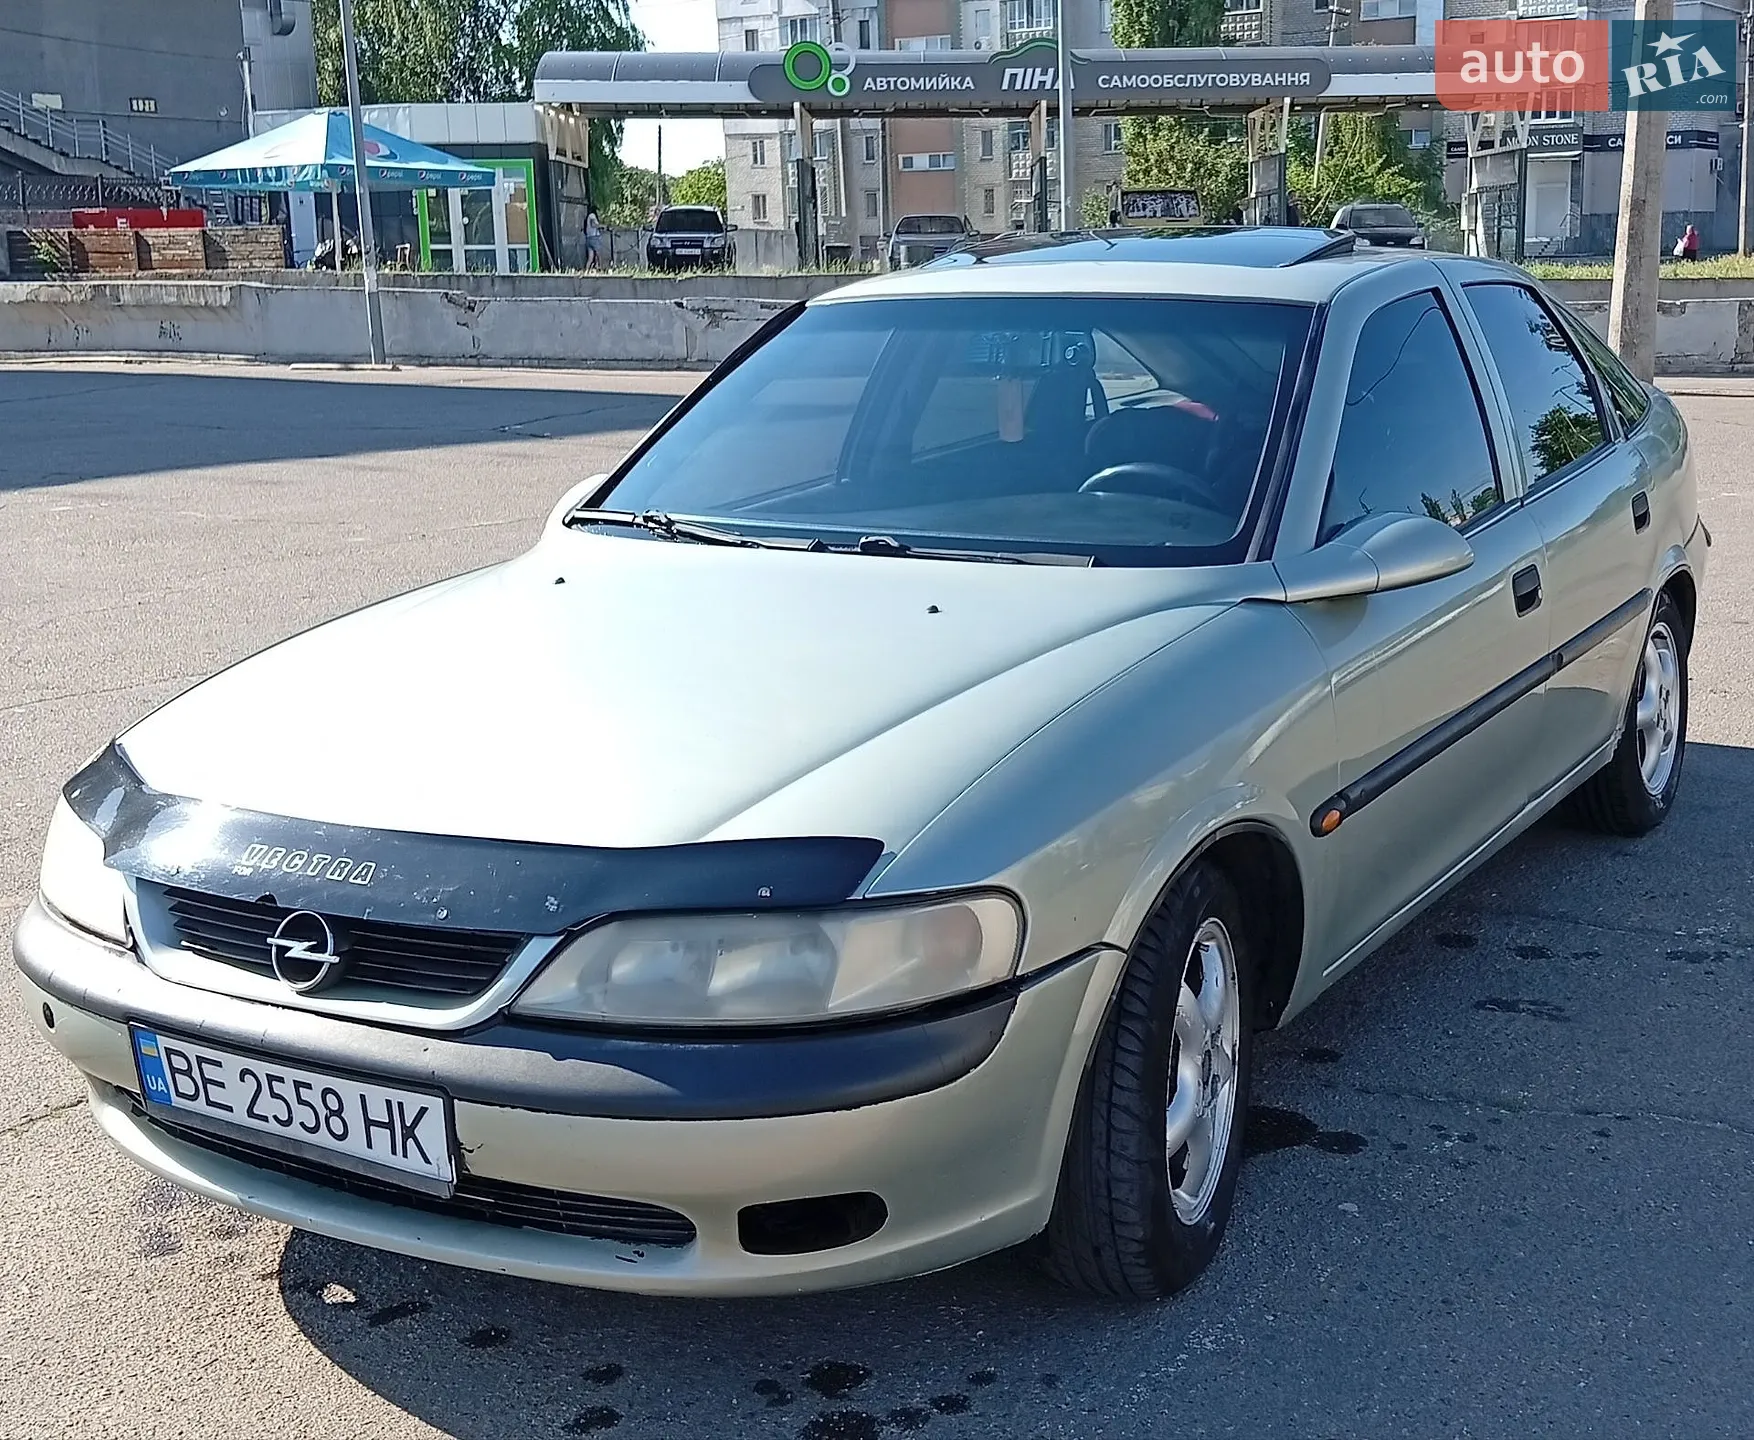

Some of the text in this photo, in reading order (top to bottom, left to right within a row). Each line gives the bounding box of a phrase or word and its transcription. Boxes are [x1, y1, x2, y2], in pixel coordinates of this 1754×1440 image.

[863, 73, 975, 91] АВТОМИЙКА
[1097, 72, 1311, 88] САМООБСЛУГОВУВАННЯ
[1542, 133, 1579, 146] STONE
[241, 843, 377, 885] VECTRA
[148, 1075, 168, 1094] UA
[163, 1046, 432, 1165] BE 2558 HK
